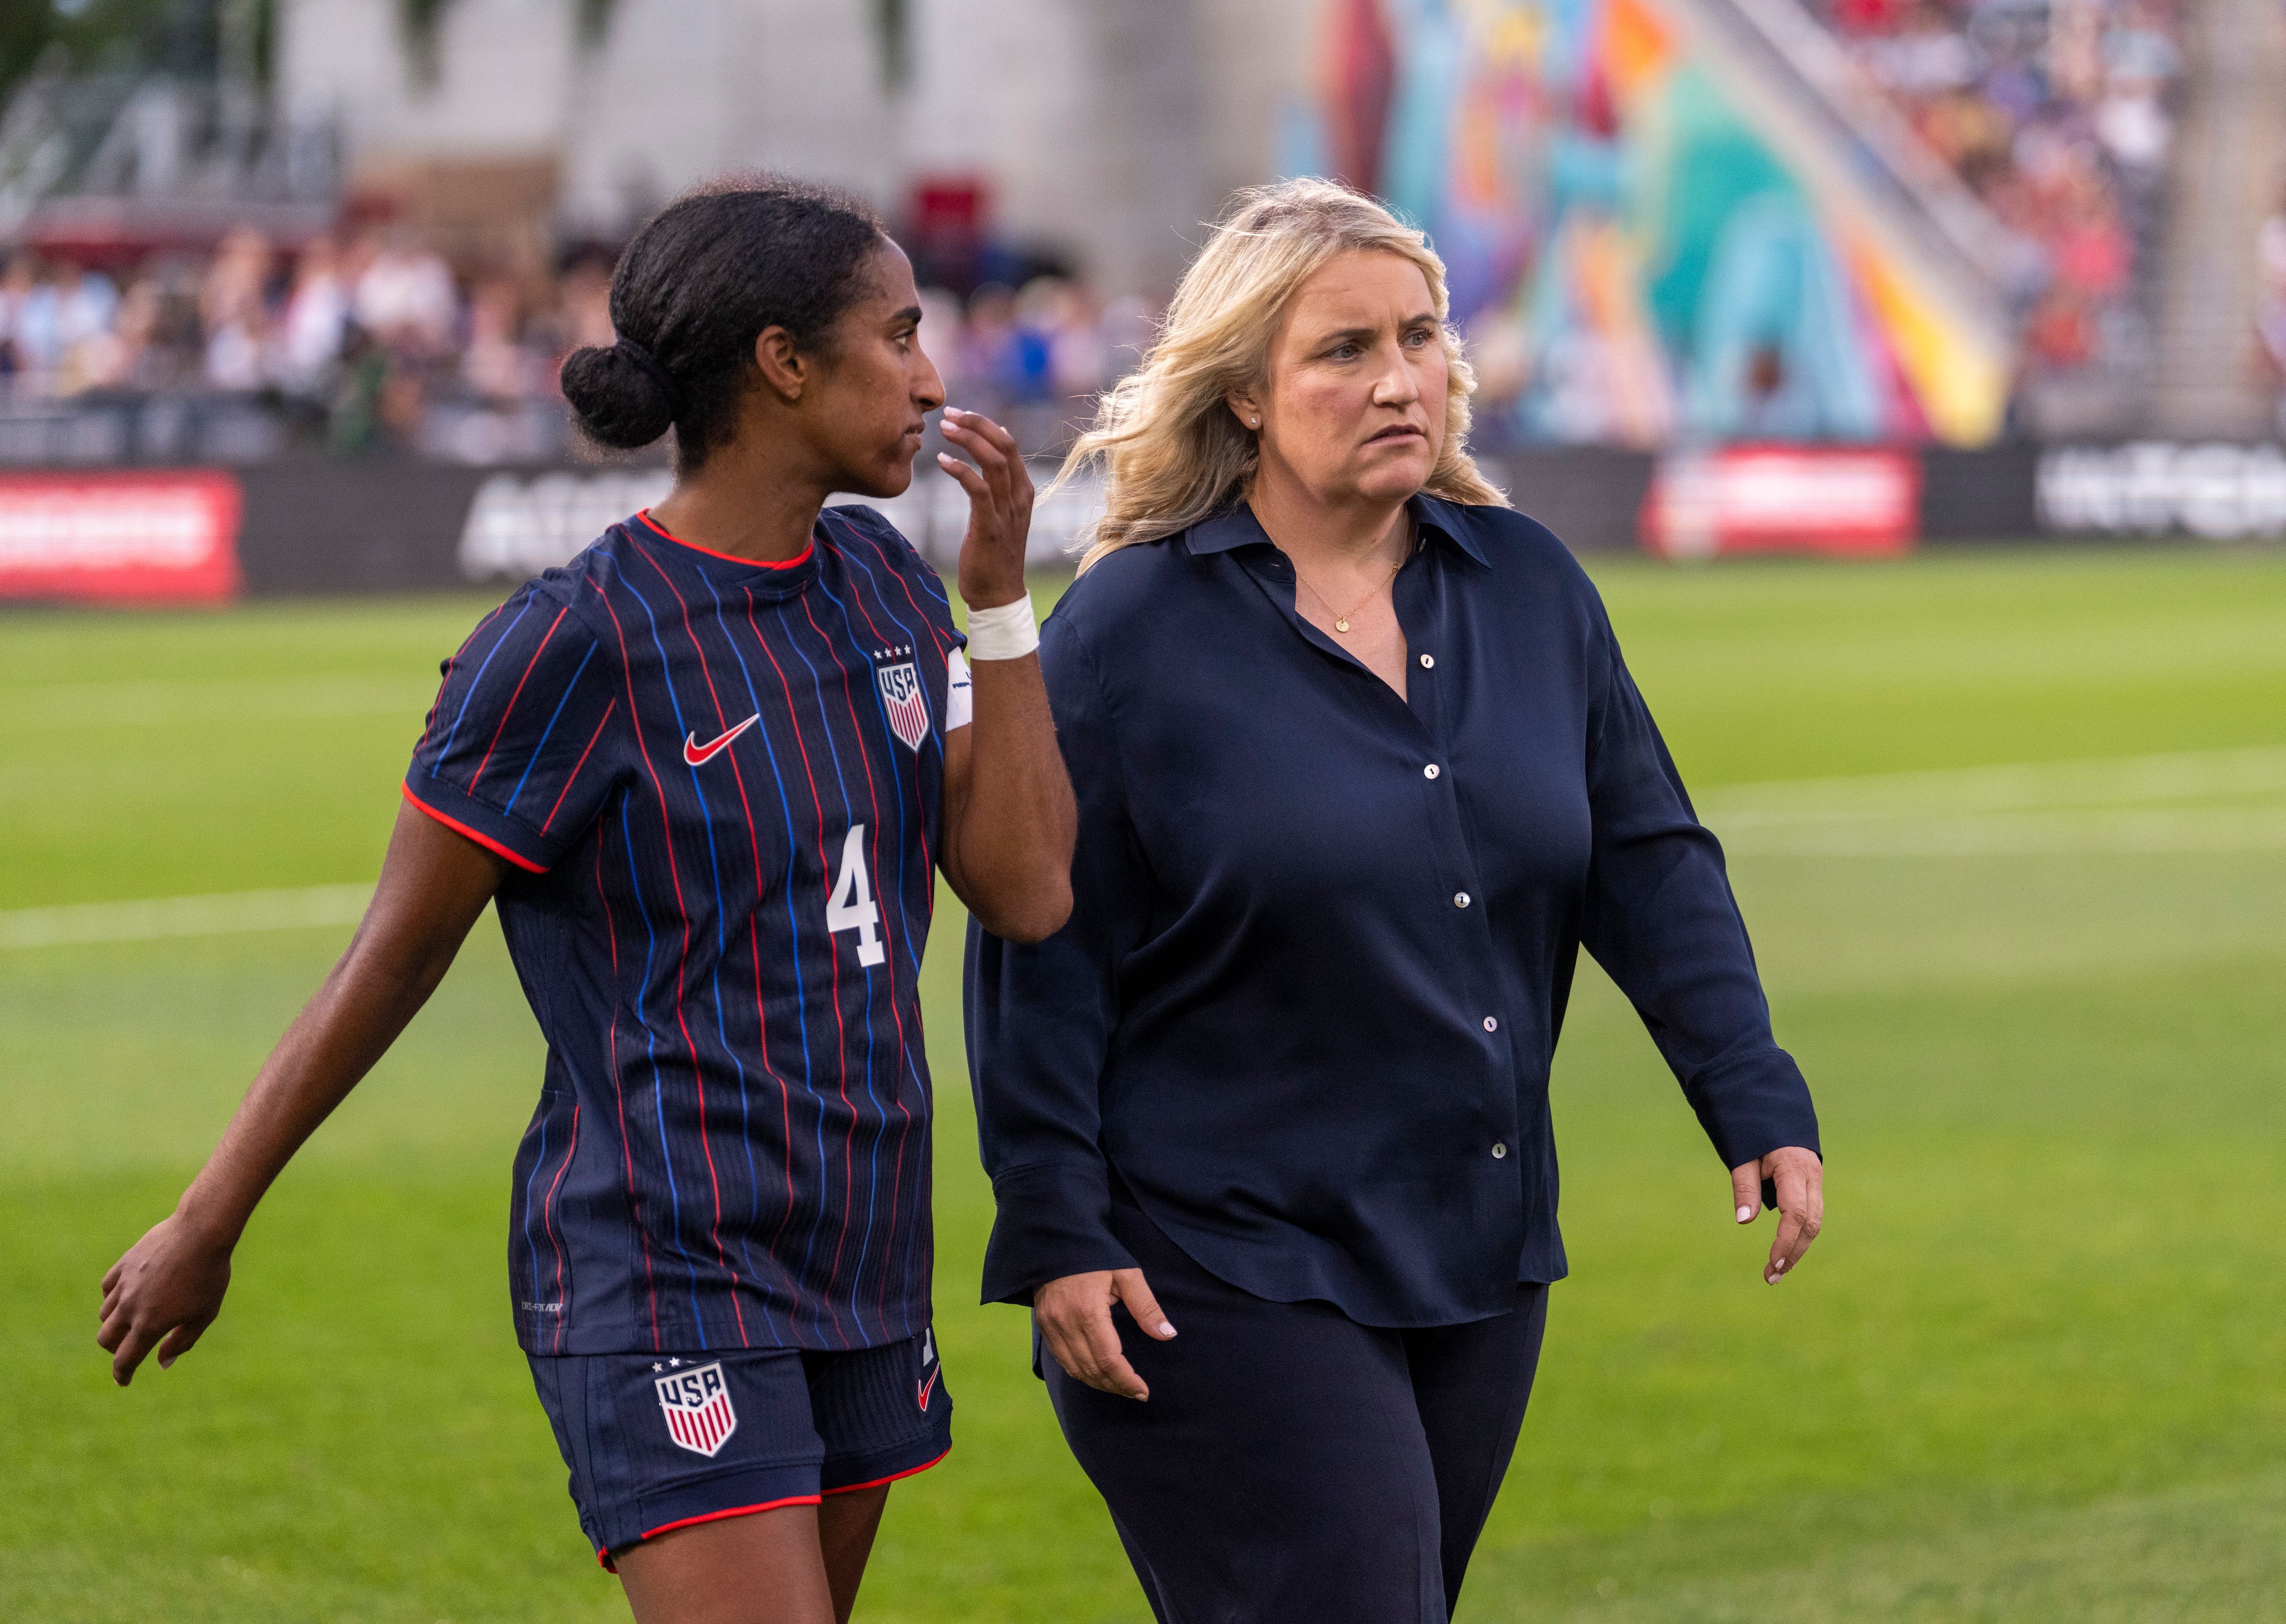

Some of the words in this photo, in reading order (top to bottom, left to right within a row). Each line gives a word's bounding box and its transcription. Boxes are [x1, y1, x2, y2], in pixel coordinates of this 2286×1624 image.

[881, 667, 915, 702] USA
[826, 824, 885, 967] 4
[661, 1368, 721, 1407] USA
